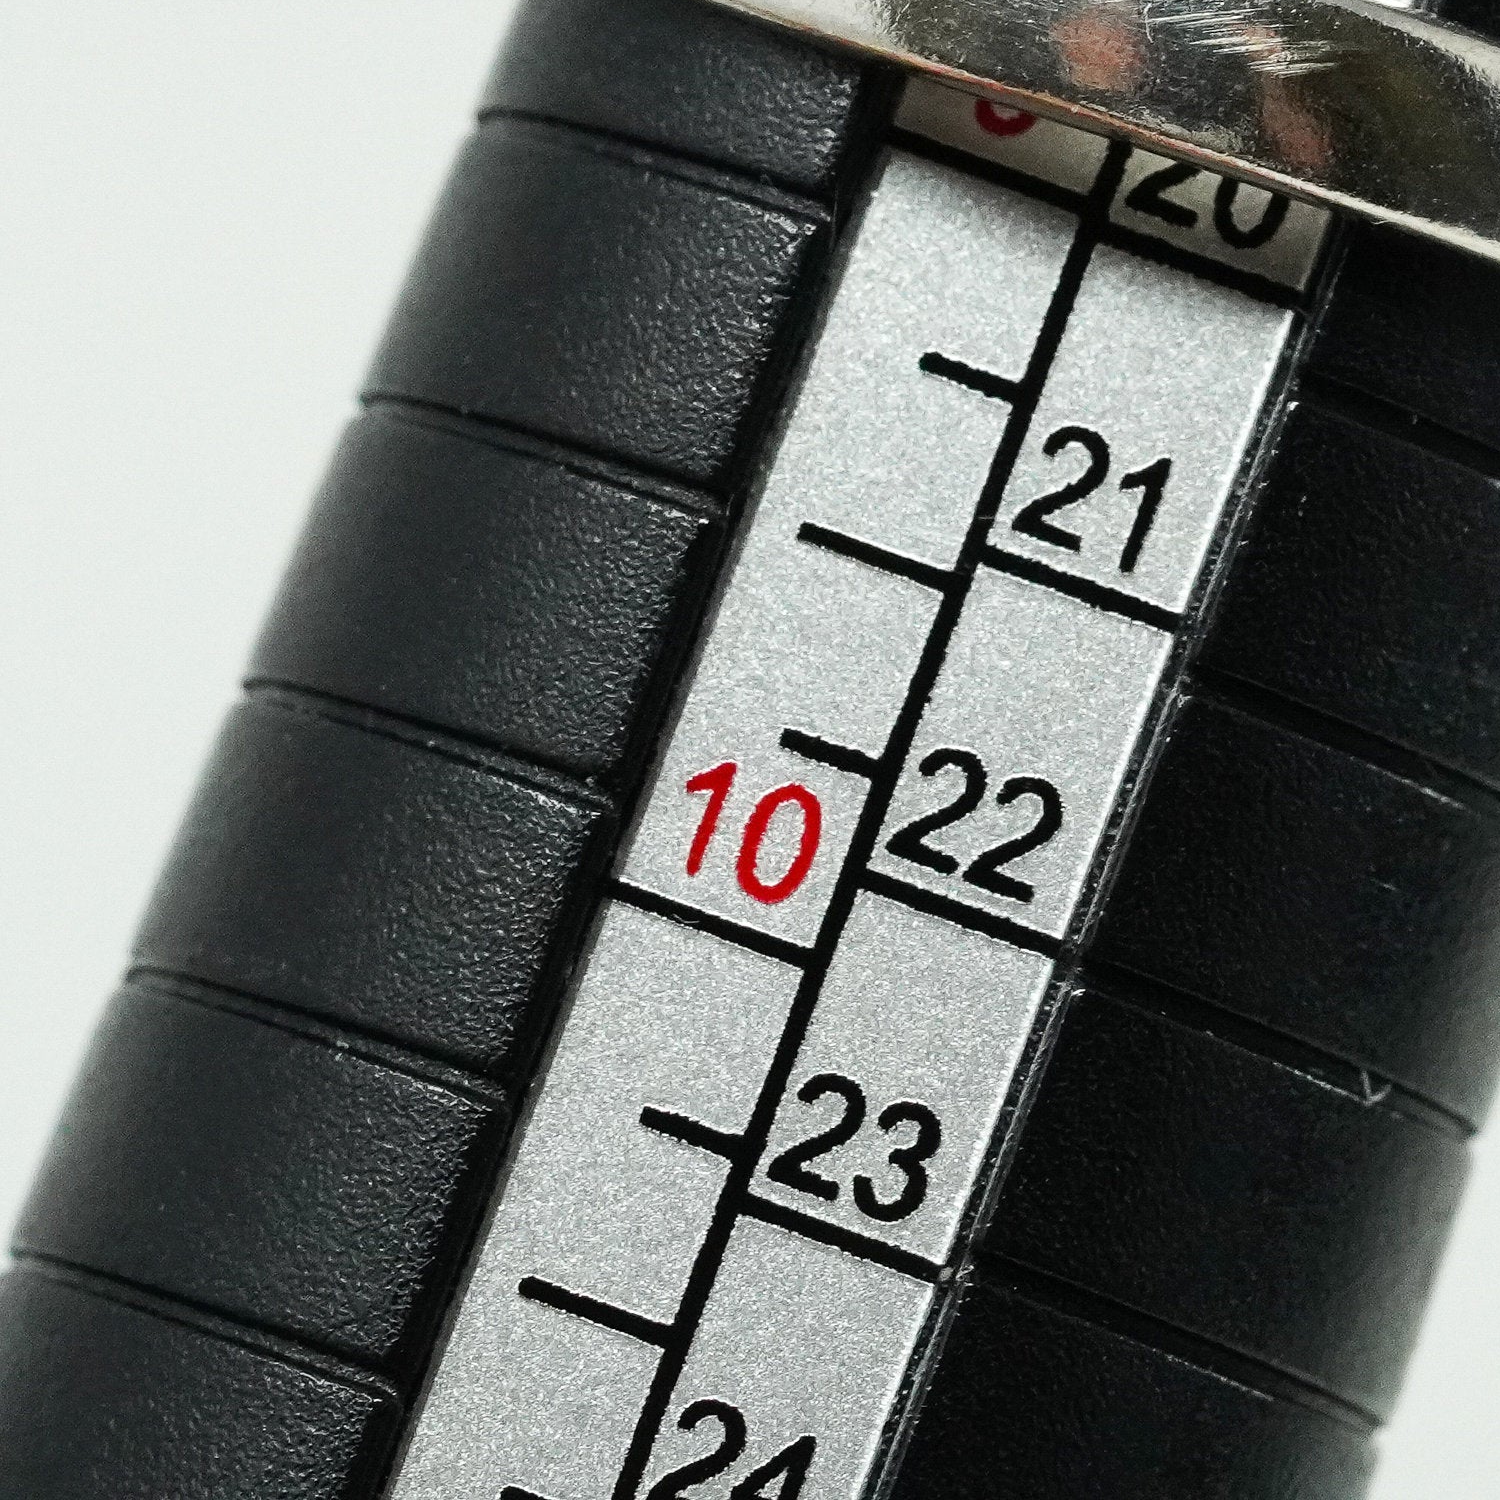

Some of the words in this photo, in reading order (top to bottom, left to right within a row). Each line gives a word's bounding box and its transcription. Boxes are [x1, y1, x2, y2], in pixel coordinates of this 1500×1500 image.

[1009, 424, 1174, 575] 21
[684, 760, 824, 906] 10
[883, 746, 1067, 905] 22
[764, 1071, 944, 1224] 23
